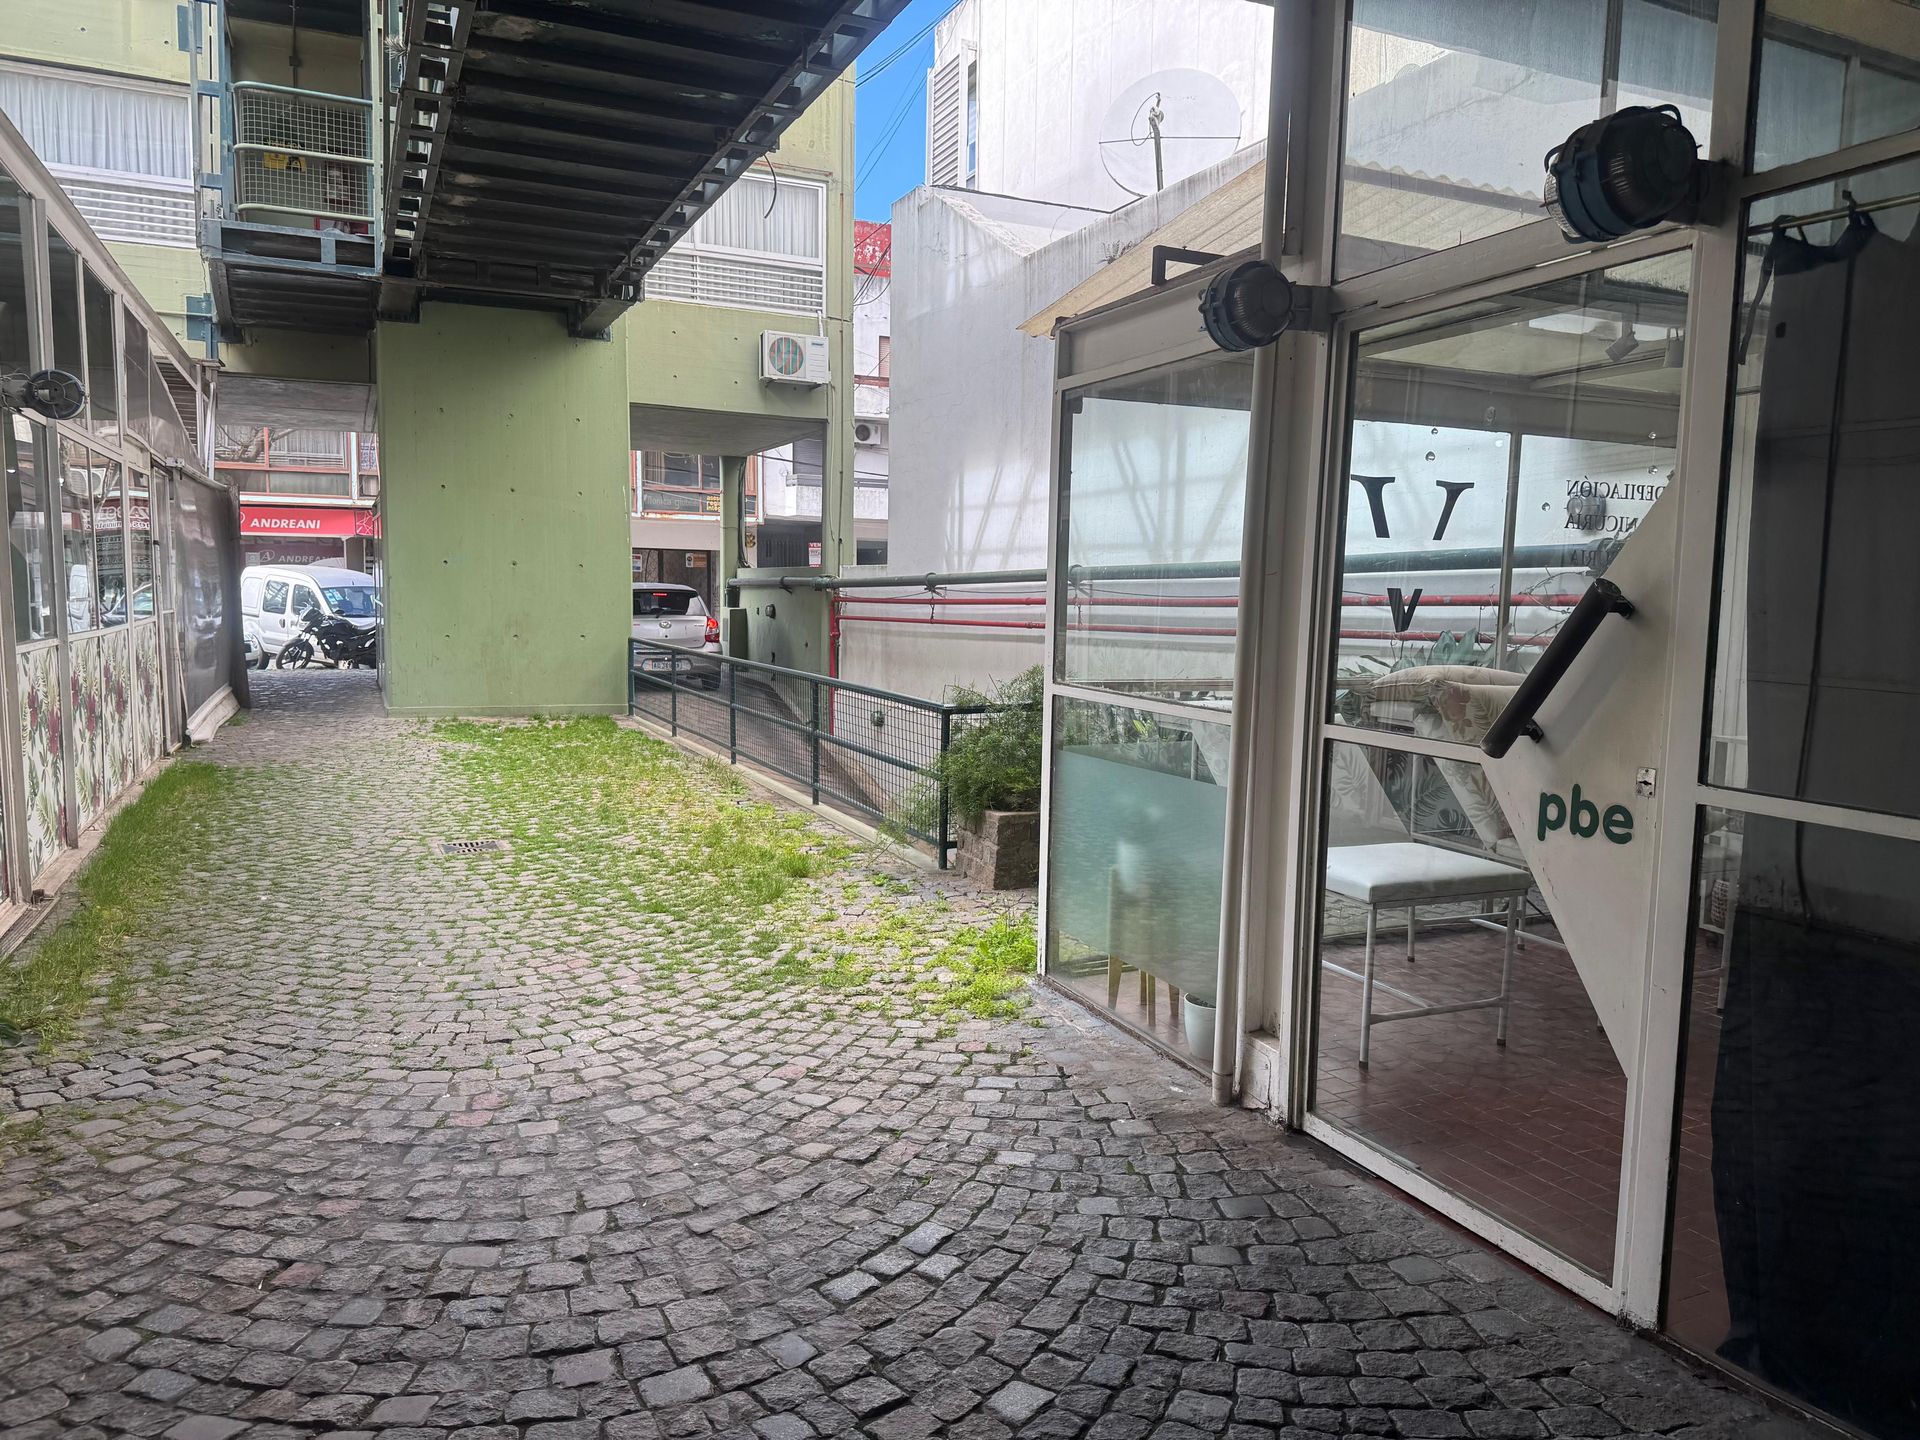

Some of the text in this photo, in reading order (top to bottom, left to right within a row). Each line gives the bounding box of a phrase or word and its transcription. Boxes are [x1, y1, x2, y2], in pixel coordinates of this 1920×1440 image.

[250, 519, 321, 529] ANDREANI
[278, 555, 332, 563] ANDREA
[1537, 783, 1634, 844] pbe
